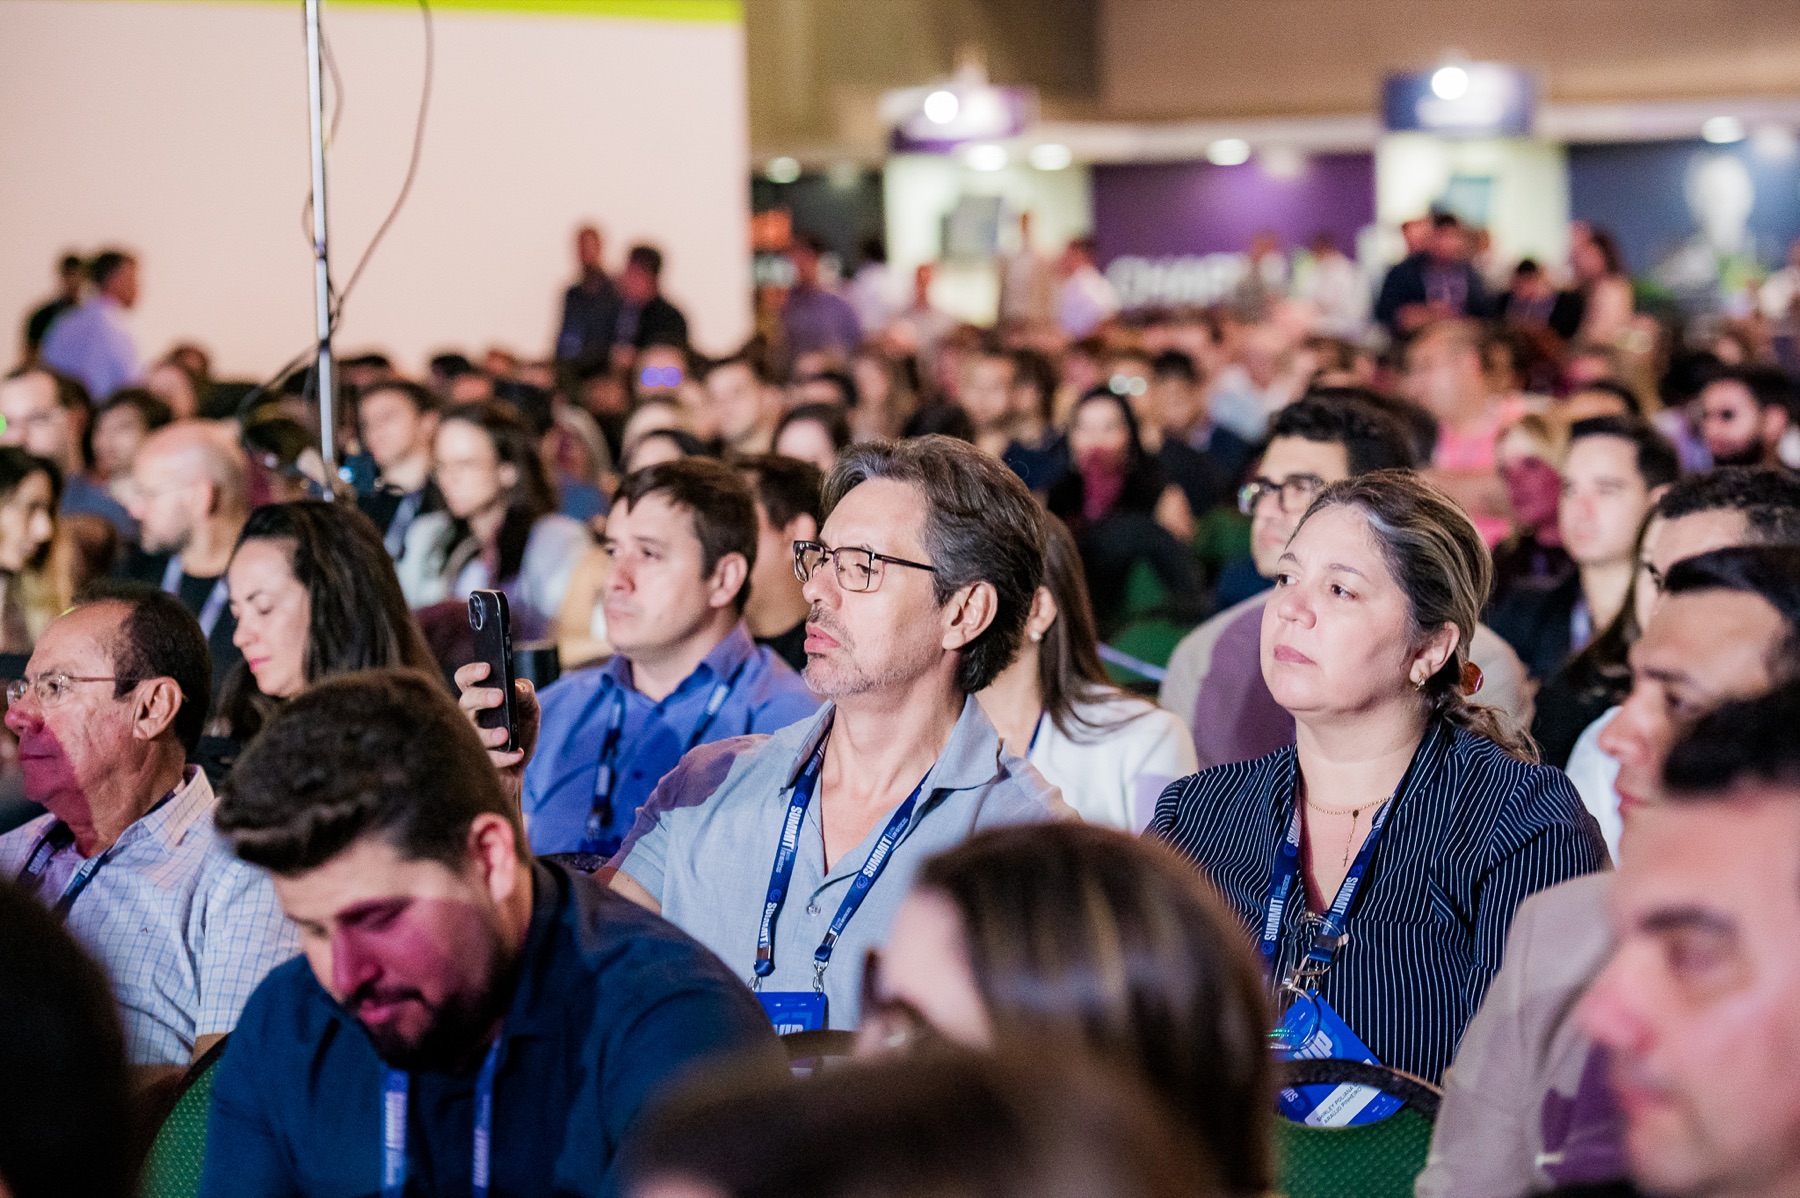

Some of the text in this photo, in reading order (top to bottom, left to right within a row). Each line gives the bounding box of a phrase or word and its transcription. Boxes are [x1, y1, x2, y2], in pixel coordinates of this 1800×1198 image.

[782, 805, 803, 850] SUMMIT
[862, 835, 893, 878] SUMMIT
[1331, 876, 1358, 916] SUMMIT
[1264, 897, 1284, 941] SUMMIT
